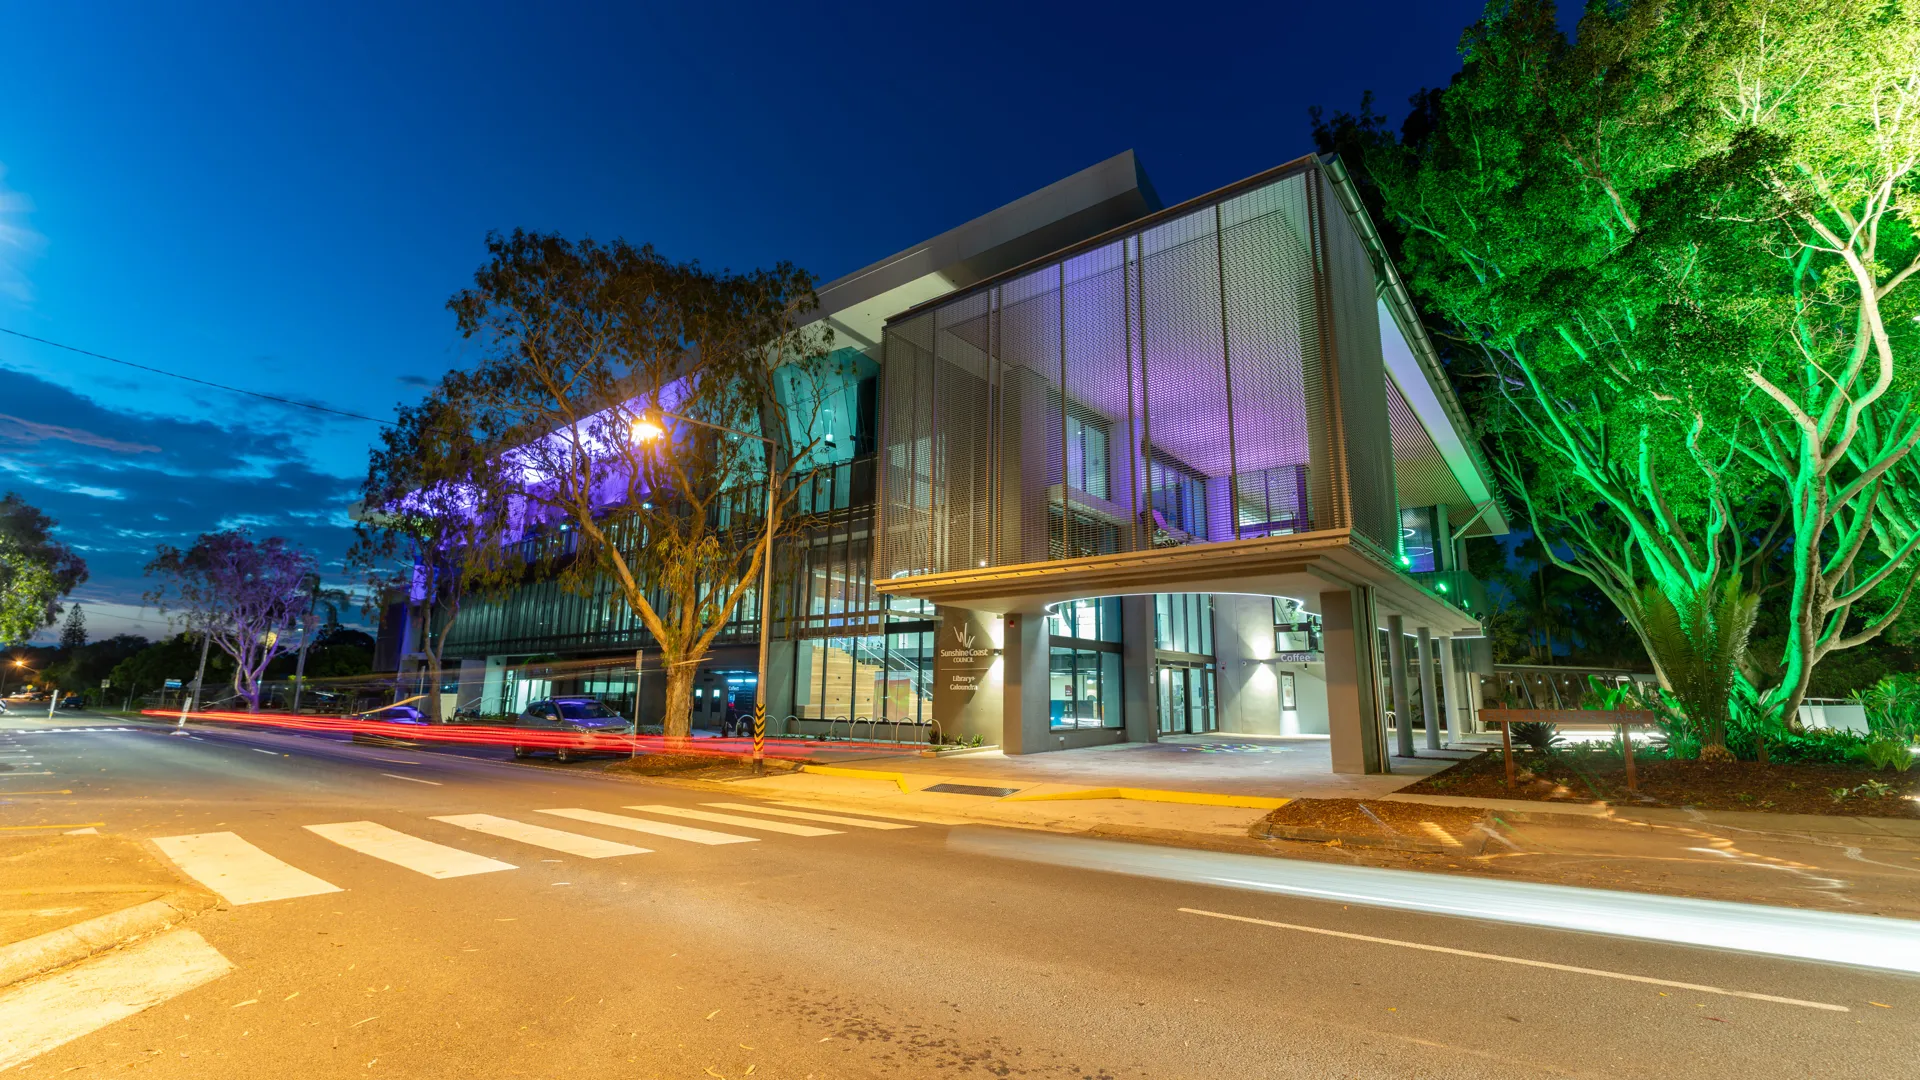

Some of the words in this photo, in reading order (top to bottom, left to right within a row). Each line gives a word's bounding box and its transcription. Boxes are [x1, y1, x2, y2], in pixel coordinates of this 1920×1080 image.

[941, 649, 968, 657] Sunshine
[969, 648, 988, 656] Coast
[1280, 653, 1311, 662] Coffee
[1605, 711, 1643, 721] PARK
